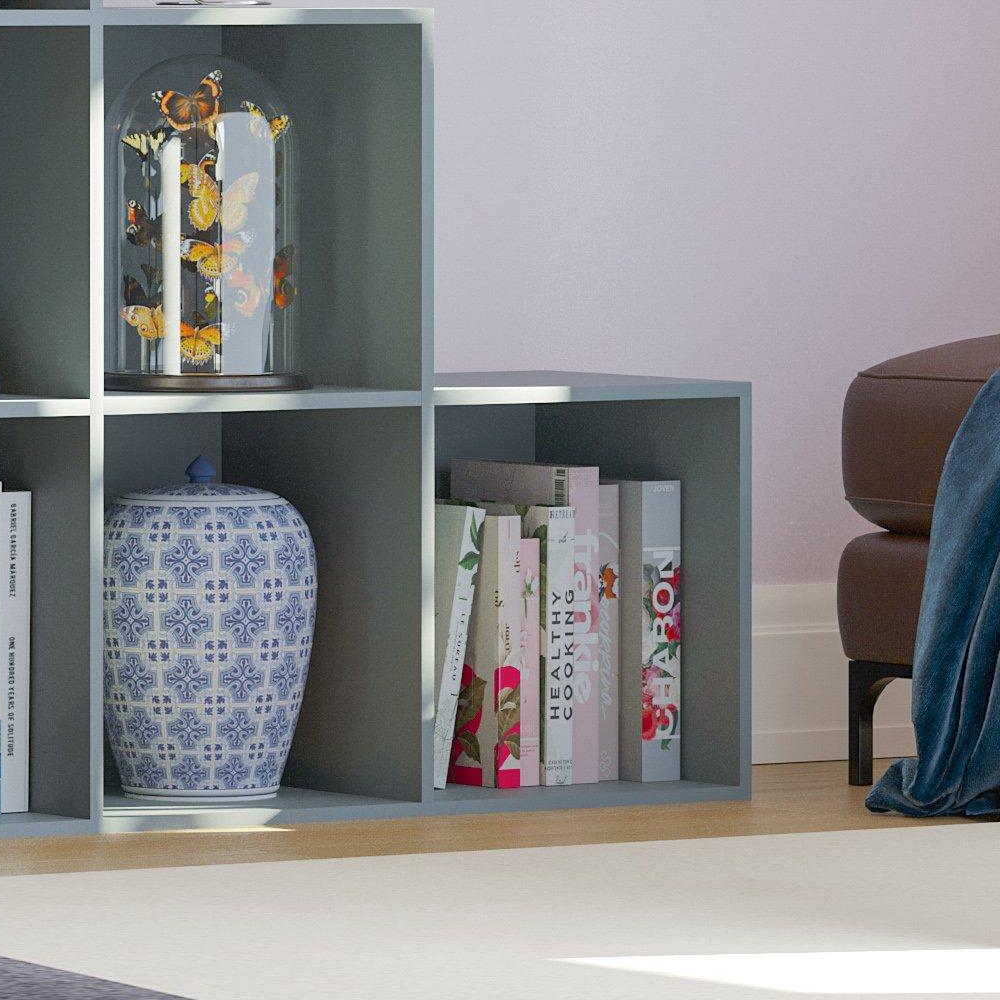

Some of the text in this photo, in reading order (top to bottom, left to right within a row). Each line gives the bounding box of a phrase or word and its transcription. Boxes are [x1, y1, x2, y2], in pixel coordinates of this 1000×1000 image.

[550, 591, 563, 720] HEALTHY
[563, 589, 575, 721] COOKING
[573, 529, 600, 702] frankie
[652, 550, 675, 740] CHABON
[7, 723, 15, 757] SOLITUDE
[8, 712, 15, 721] OF
